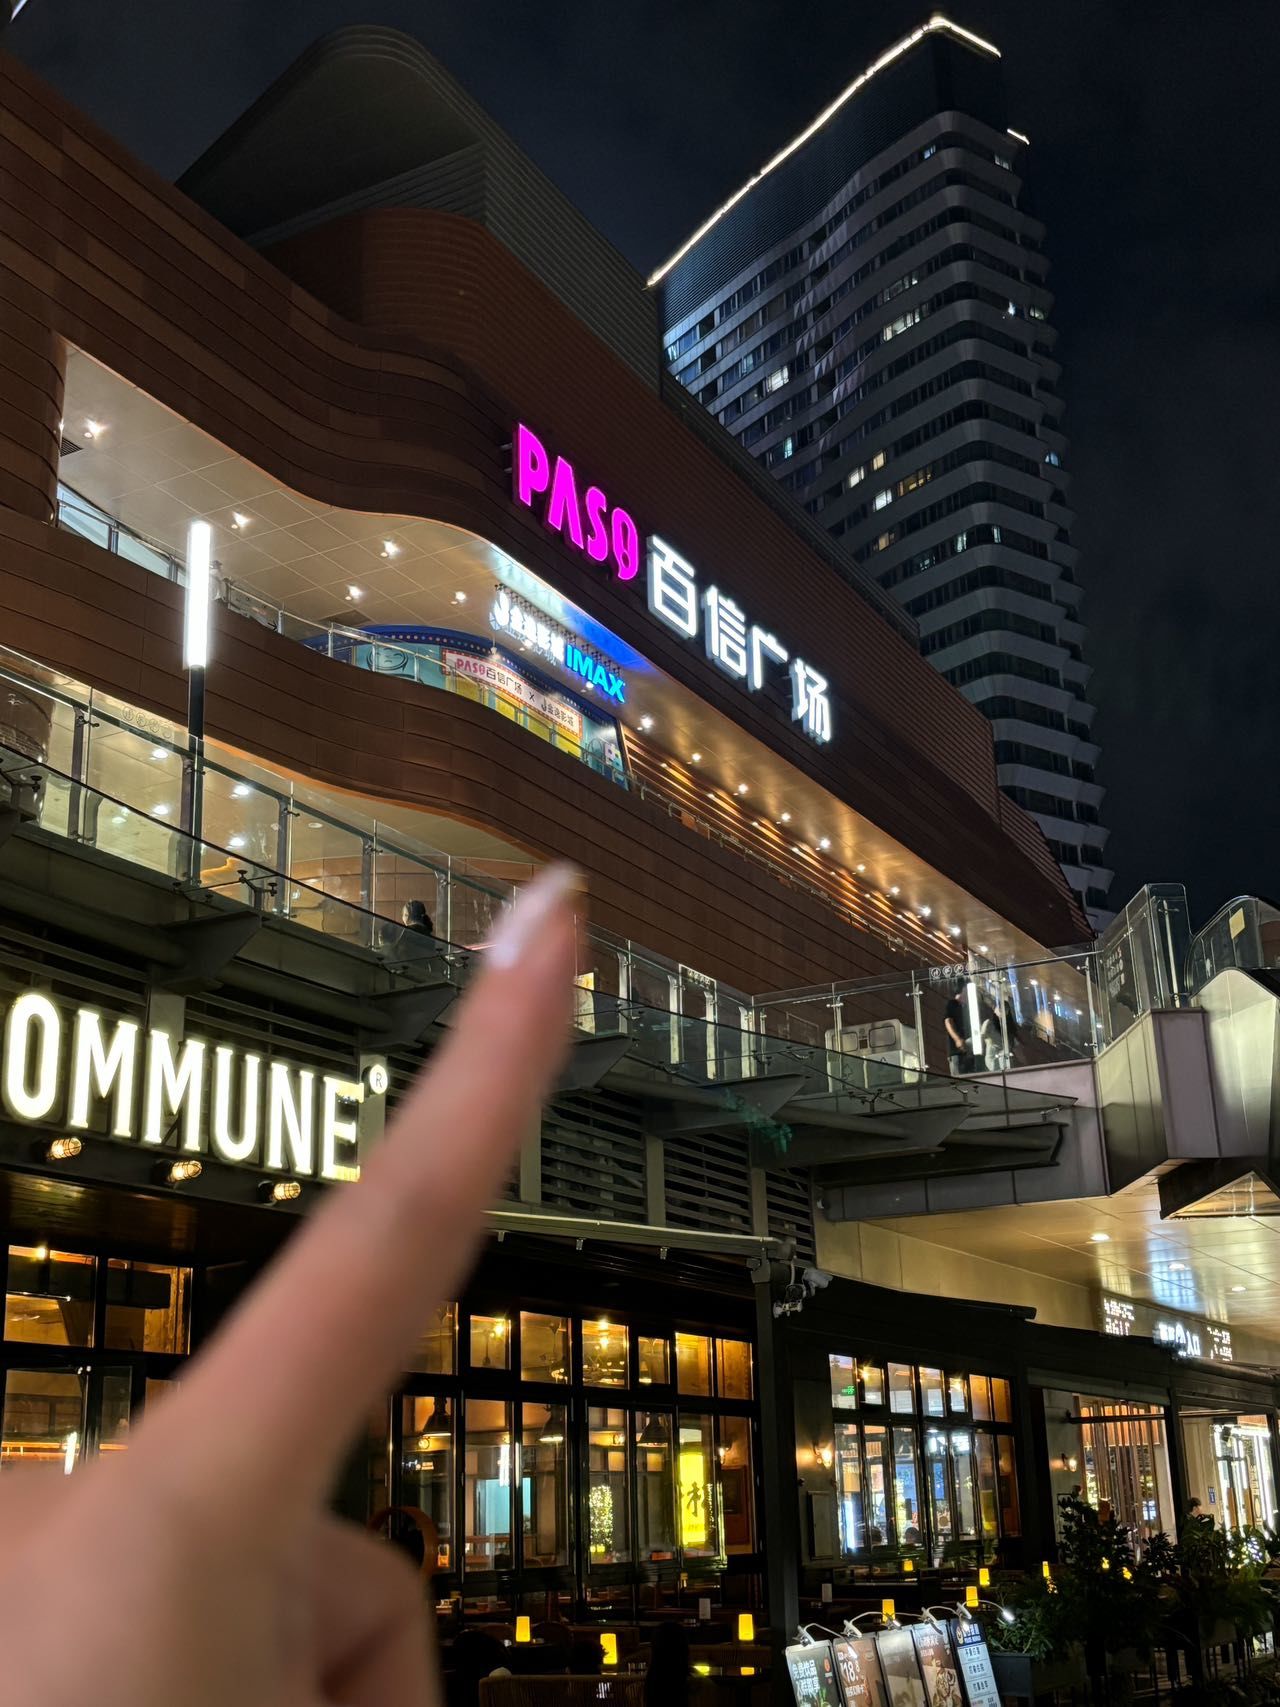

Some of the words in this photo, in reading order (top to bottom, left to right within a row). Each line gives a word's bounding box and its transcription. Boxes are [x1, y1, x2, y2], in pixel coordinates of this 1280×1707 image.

[486, 667, 523, 695] 百信广场
[566, 644, 626, 703] IMAX
[647, 534, 832, 744] 百信广场
[7, 993, 364, 1183] OMMUNE
